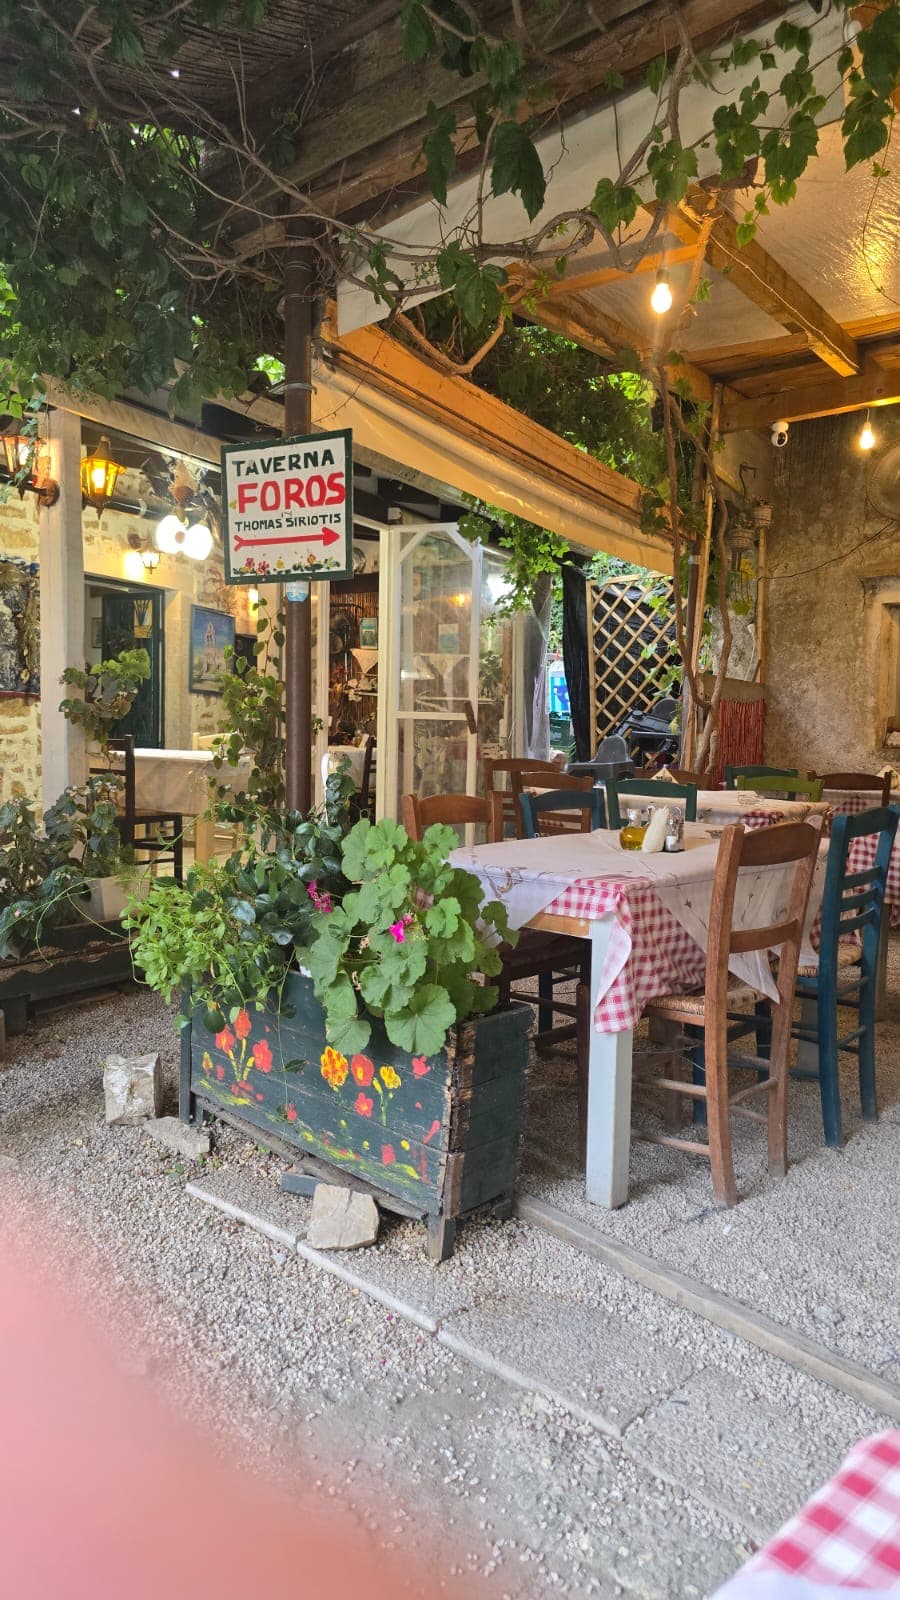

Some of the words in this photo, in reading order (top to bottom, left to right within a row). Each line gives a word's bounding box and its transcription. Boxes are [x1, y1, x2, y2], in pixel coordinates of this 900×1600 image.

[232, 449, 335, 476] TAVERNA
[237, 471, 346, 514] FOROS
[234, 518, 283, 532] THOMAS
[285, 513, 341, 528] SIRIOTIS
